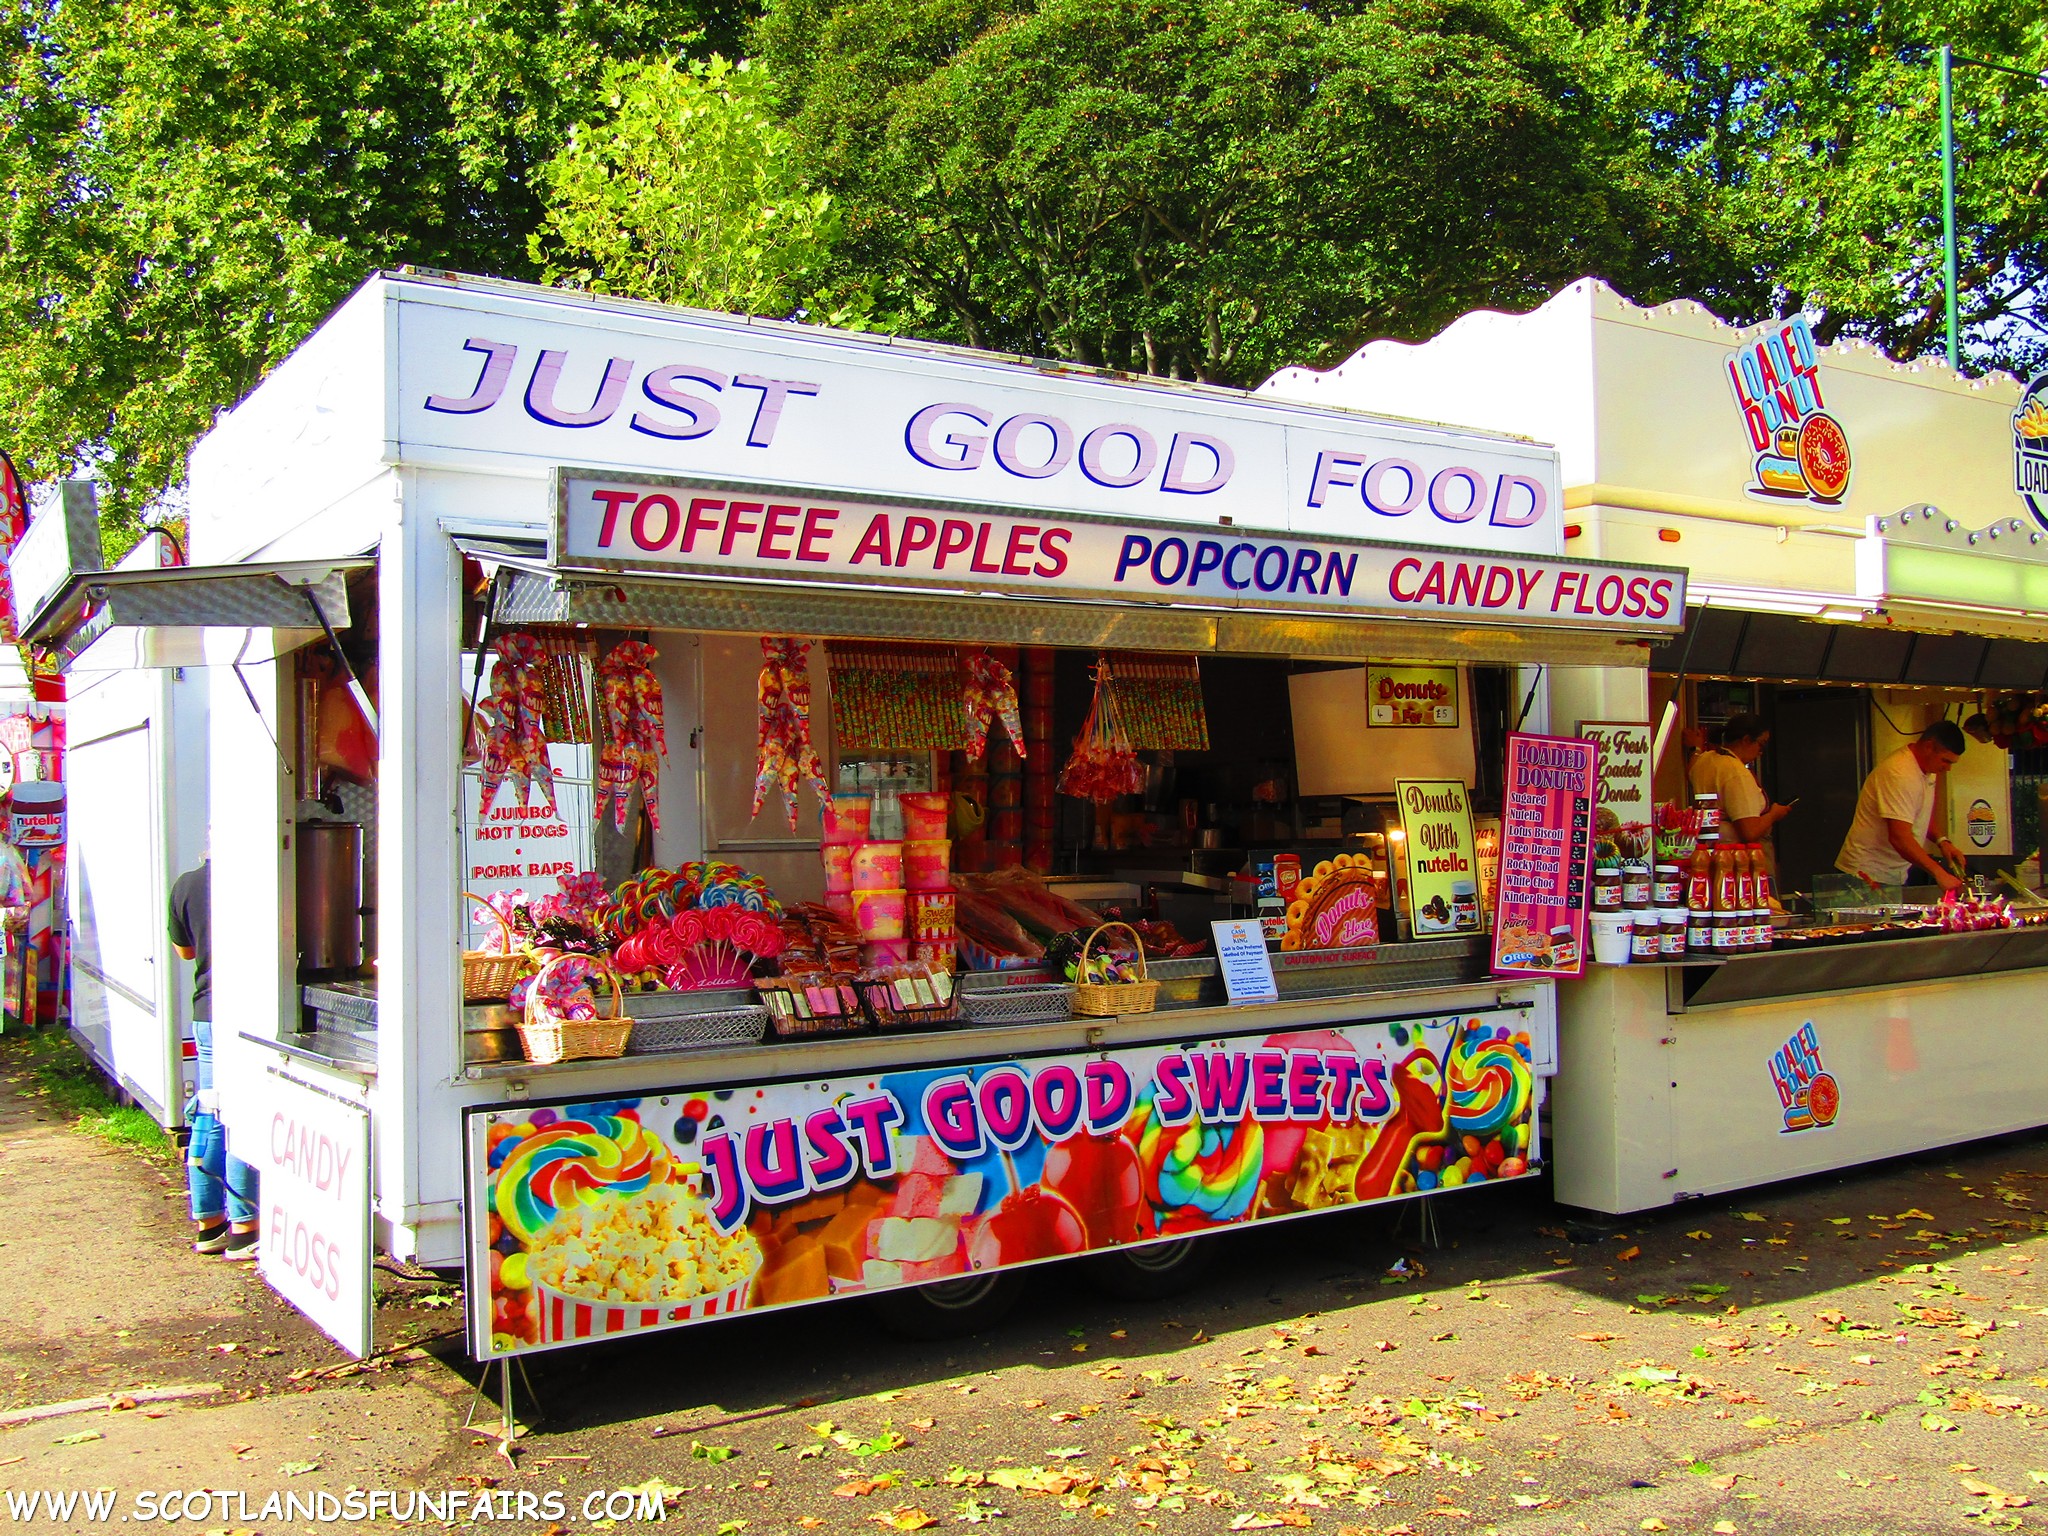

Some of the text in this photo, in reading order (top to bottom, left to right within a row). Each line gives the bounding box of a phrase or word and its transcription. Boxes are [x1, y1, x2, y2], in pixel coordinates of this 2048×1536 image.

[1728, 319, 1815, 411] LOADED
[1744, 365, 1825, 453] DONUT
[424, 336, 1548, 529] JUST GOOD FOOD
[592, 489, 1675, 620] TOFFEE APPLES POPCORN CANDY FLOSS
[1380, 677, 1448, 700] Donuts
[1613, 731, 1649, 755] Fresh
[1517, 745, 1587, 770] LOADED
[1516, 766, 1586, 792] DONUTS
[1406, 786, 1463, 814] Donuts
[1511, 792, 1547, 806] Sugared
[1596, 780, 1641, 804] Donuts
[16, 813, 62, 826] nutella
[1510, 809, 1541, 822] Nutella
[476, 824, 569, 841] HOT DOGS
[1420, 823, 1461, 852] With
[1509, 825, 1532, 838] Lotus
[1534, 827, 1564, 840] Biscoff
[1508, 842, 1529, 853] Oreo
[1531, 843, 1560, 856] Dream
[472, 861, 574, 879] PORK BAPS
[1418, 852, 1469, 873] nutella
[1506, 858, 1534, 872] Rocky
[1535, 861, 1560, 872] Road
[1505, 875, 1531, 887] White
[1532, 877, 1554, 889] Choc
[1504, 891, 1534, 904] Kinder
[1536, 893, 1565, 906] Bueno
[1315, 888, 1369, 945] Donuts
[1343, 917, 1373, 940] Here
[1502, 919, 1534, 930] bueno
[1502, 952, 1533, 965] OREO
[1768, 1022, 1817, 1087] LOADED
[1777, 1046, 1823, 1109] DONUT
[702, 1049, 1391, 1226] JUST GOOD SWEETS
[271, 1112, 351, 1200] CANDY
[270, 1204, 341, 1302] FLOSS
